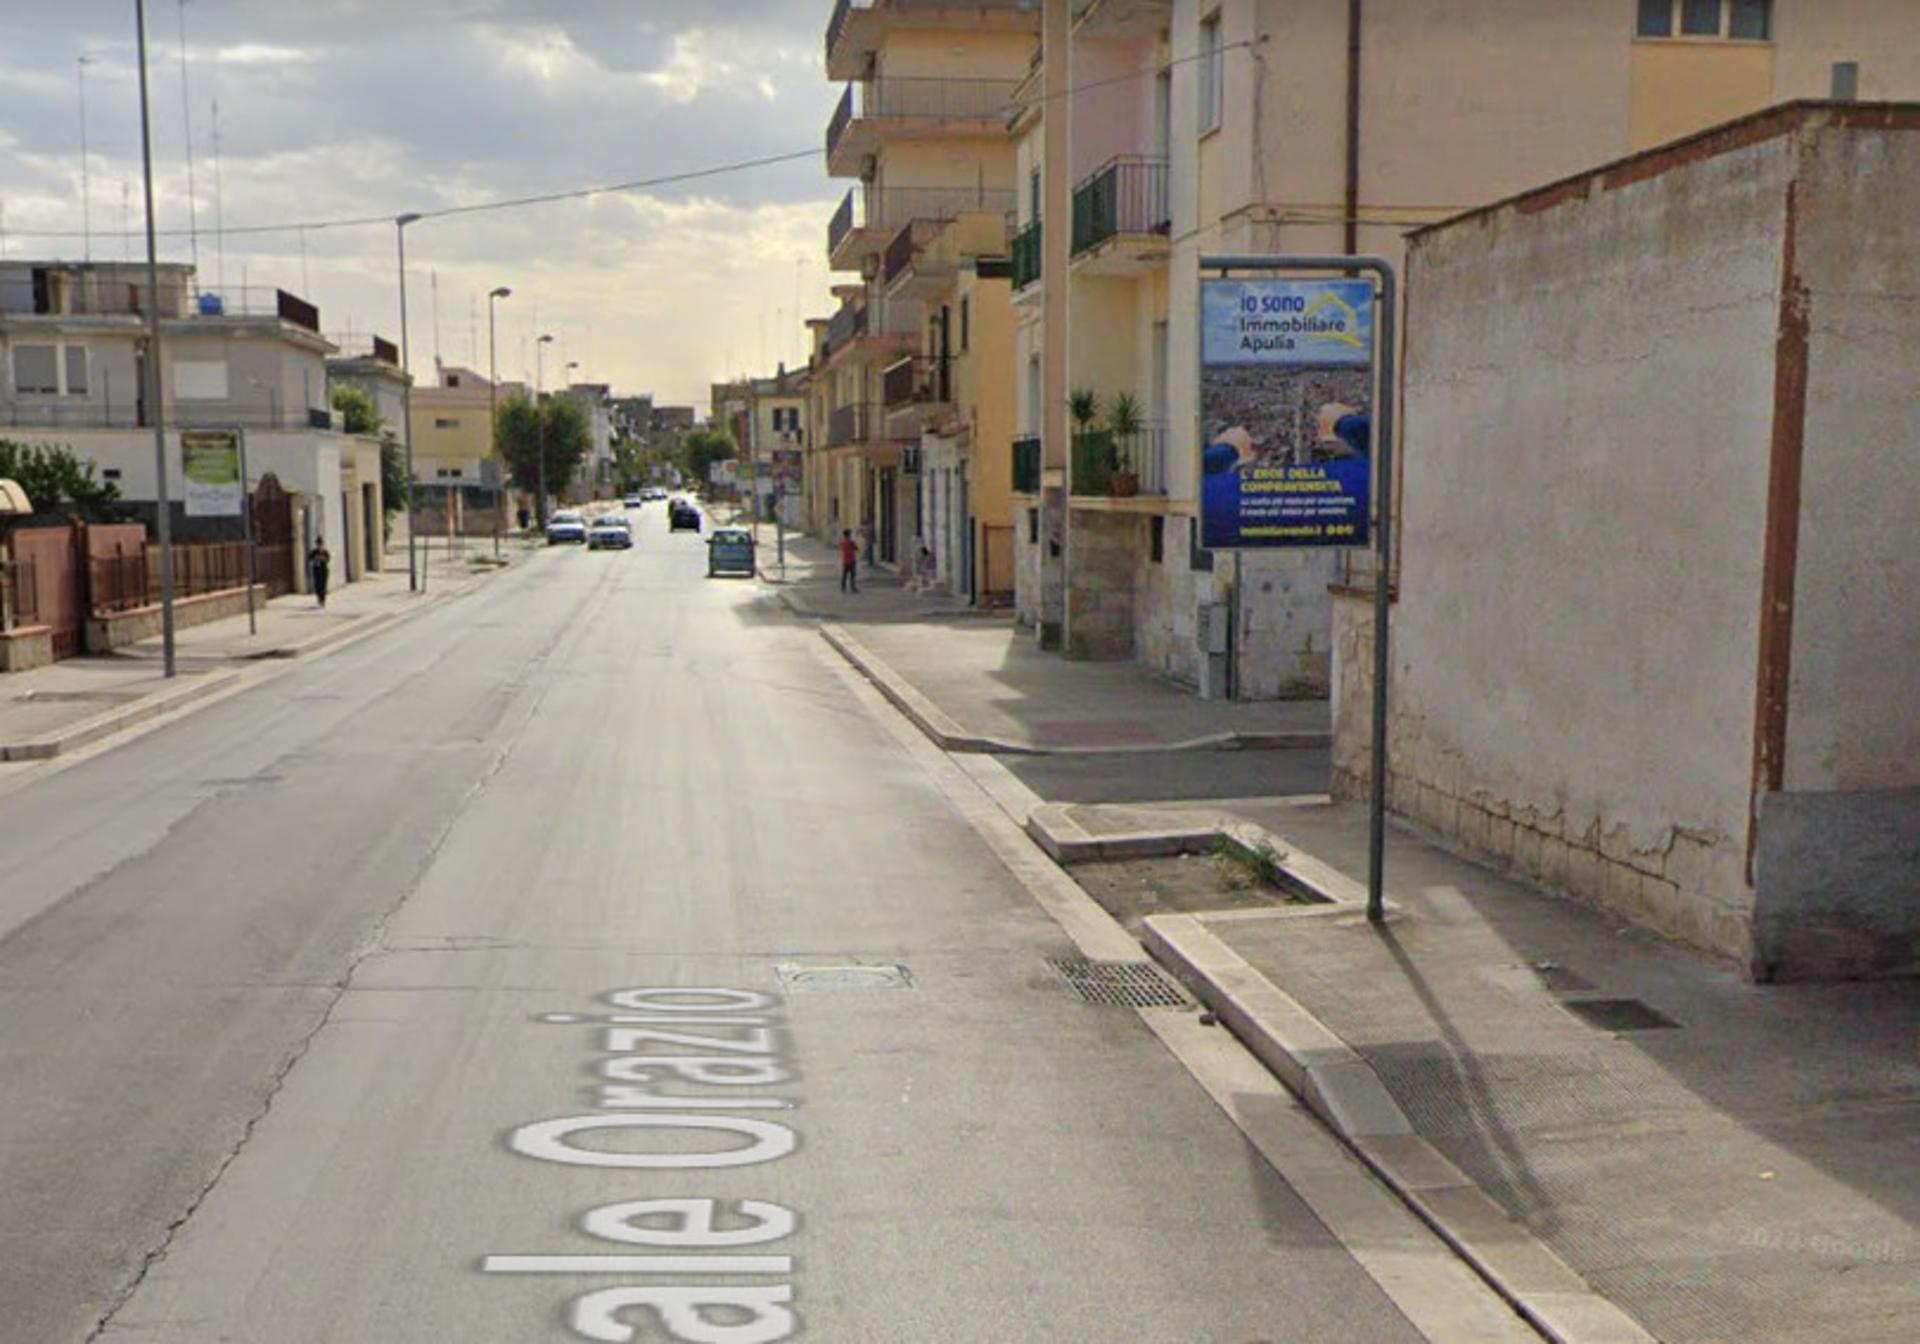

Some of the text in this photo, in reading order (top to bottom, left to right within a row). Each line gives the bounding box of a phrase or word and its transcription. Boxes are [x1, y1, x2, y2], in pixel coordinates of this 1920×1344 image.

[1261, 295, 1305, 312] sono
[1240, 316, 1346, 333] Immobiliare
[1240, 334, 1296, 354] Apulia
